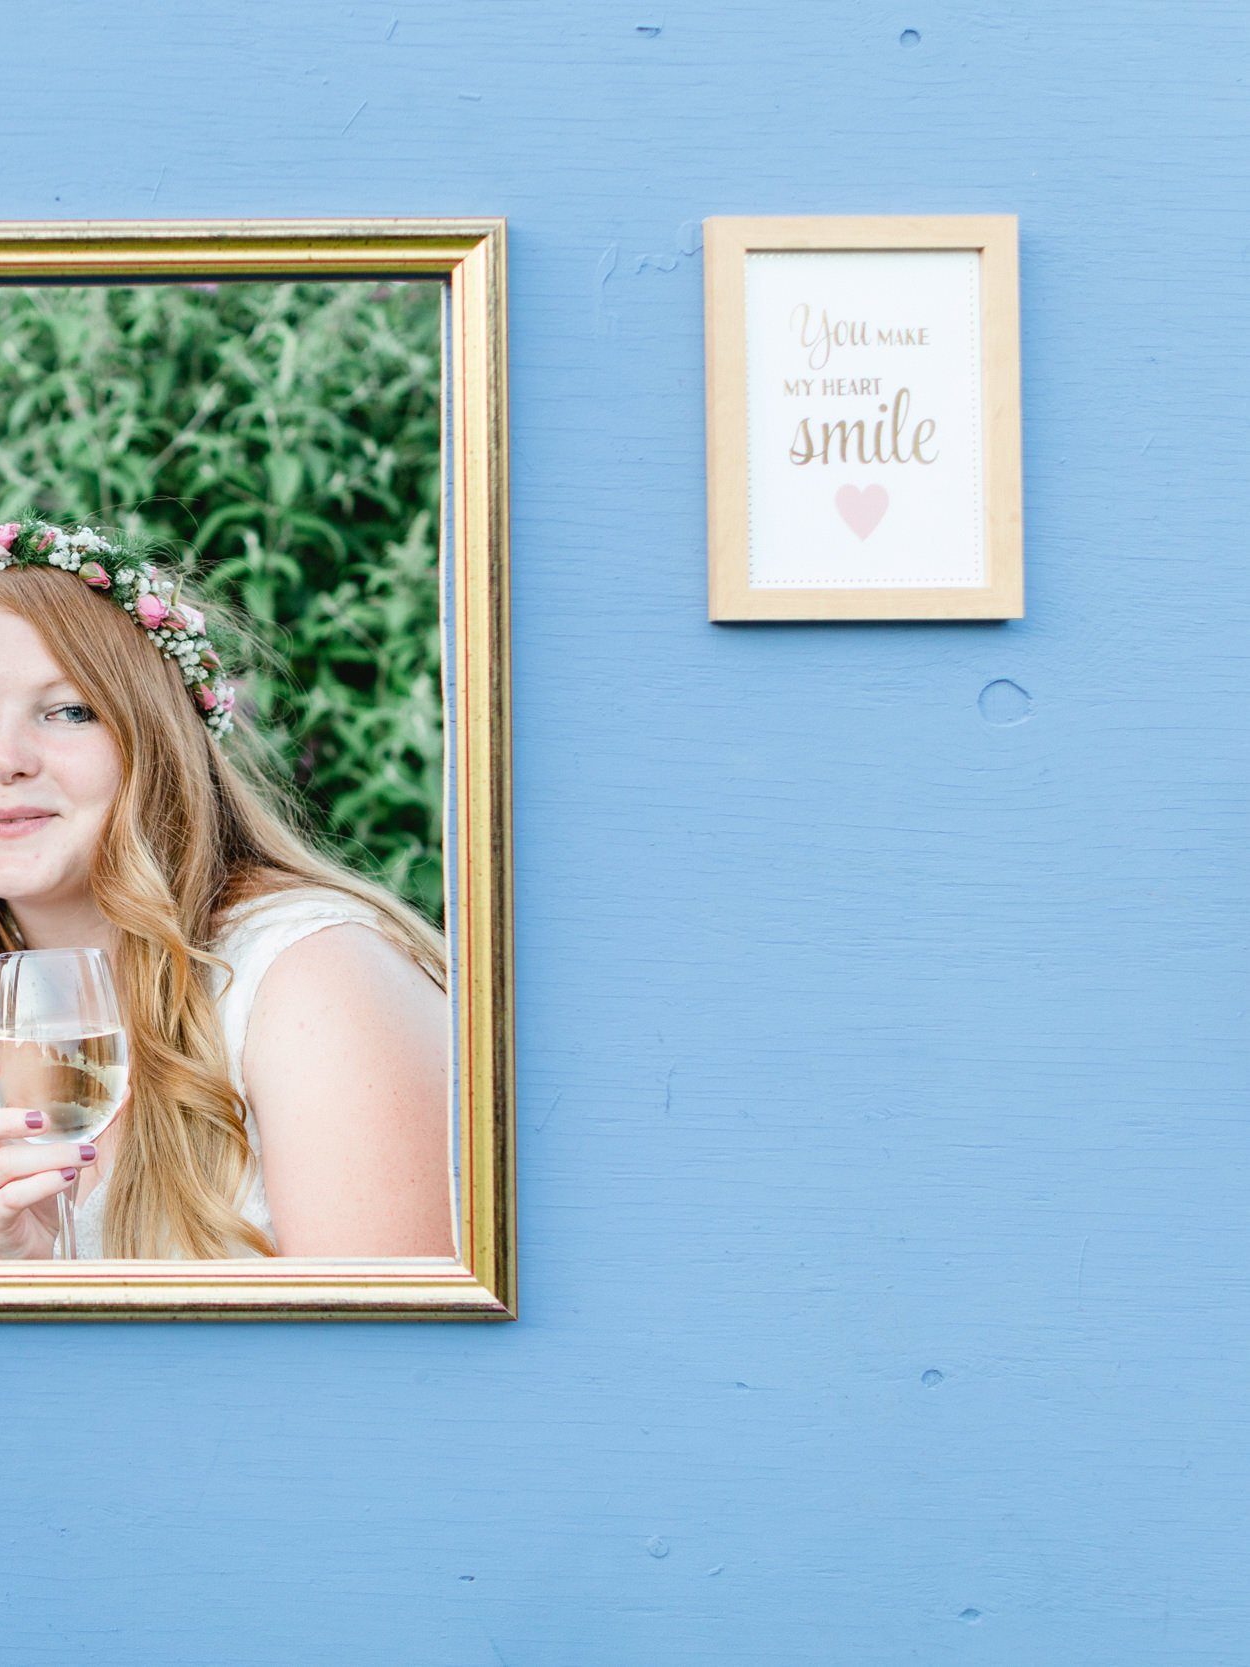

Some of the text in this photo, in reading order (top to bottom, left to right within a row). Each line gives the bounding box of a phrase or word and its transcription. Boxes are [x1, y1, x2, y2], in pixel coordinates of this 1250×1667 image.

[789, 302, 931, 371] You MAKE
[783, 377, 883, 397] MY HEART
[788, 386, 940, 466] smile
